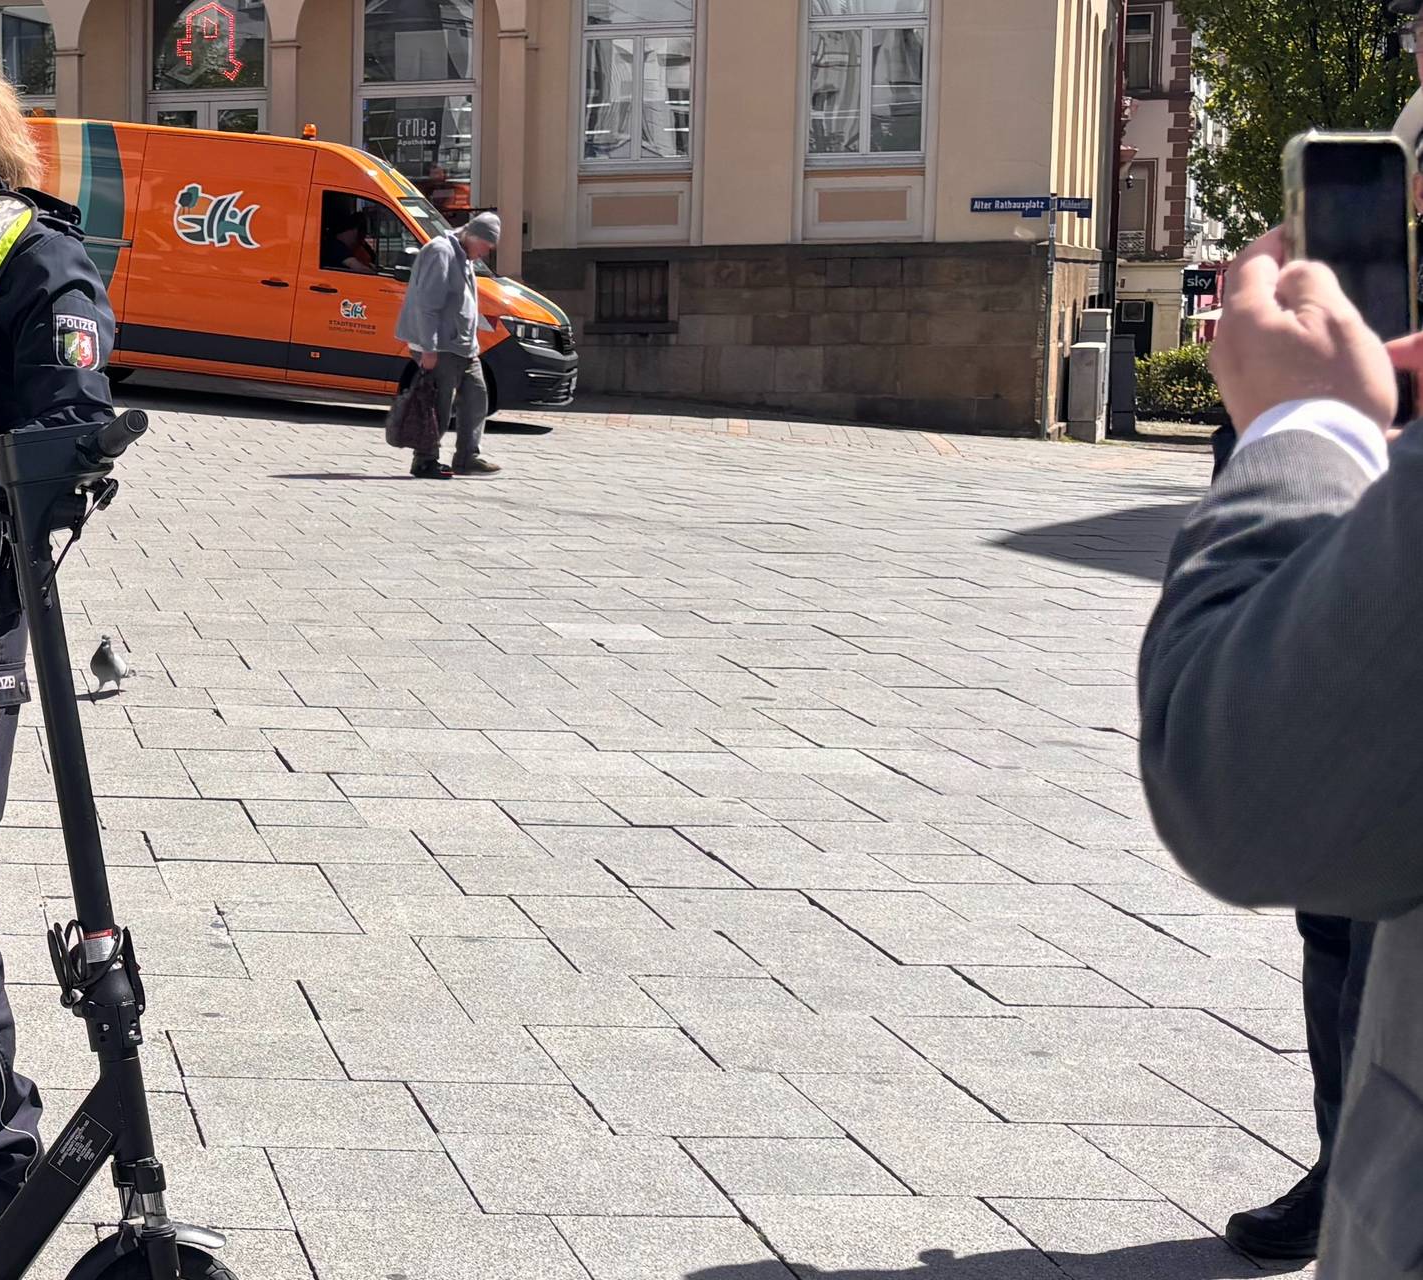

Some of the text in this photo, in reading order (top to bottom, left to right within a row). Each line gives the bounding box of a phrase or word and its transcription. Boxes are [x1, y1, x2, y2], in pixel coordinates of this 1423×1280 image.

[973, 199, 1045, 211] Alter Rathausplatz
[1187, 275, 1212, 290] sky
